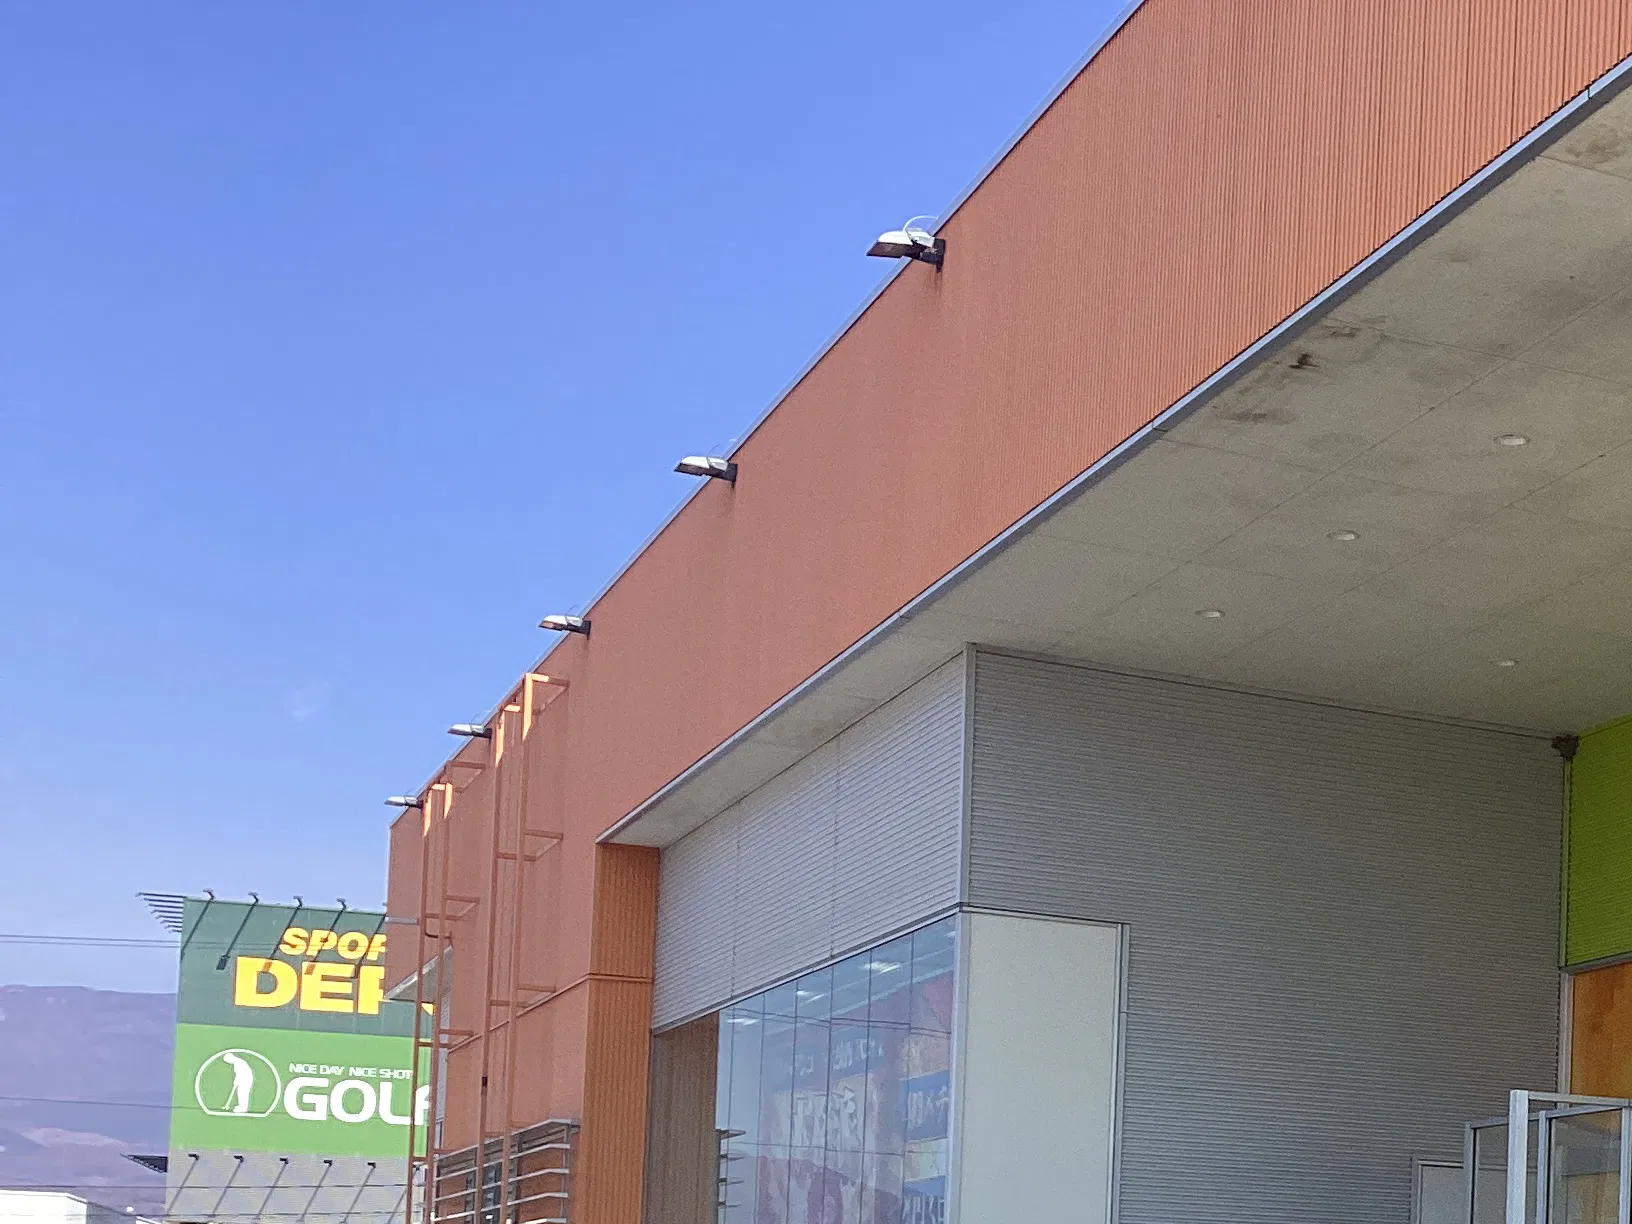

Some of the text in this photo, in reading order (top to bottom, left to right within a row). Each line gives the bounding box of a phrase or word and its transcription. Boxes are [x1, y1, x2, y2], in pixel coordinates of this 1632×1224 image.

[288, 1062, 318, 1075] NICE
[319, 1064, 345, 1076] DAY
[348, 1066, 377, 1078] NICE
